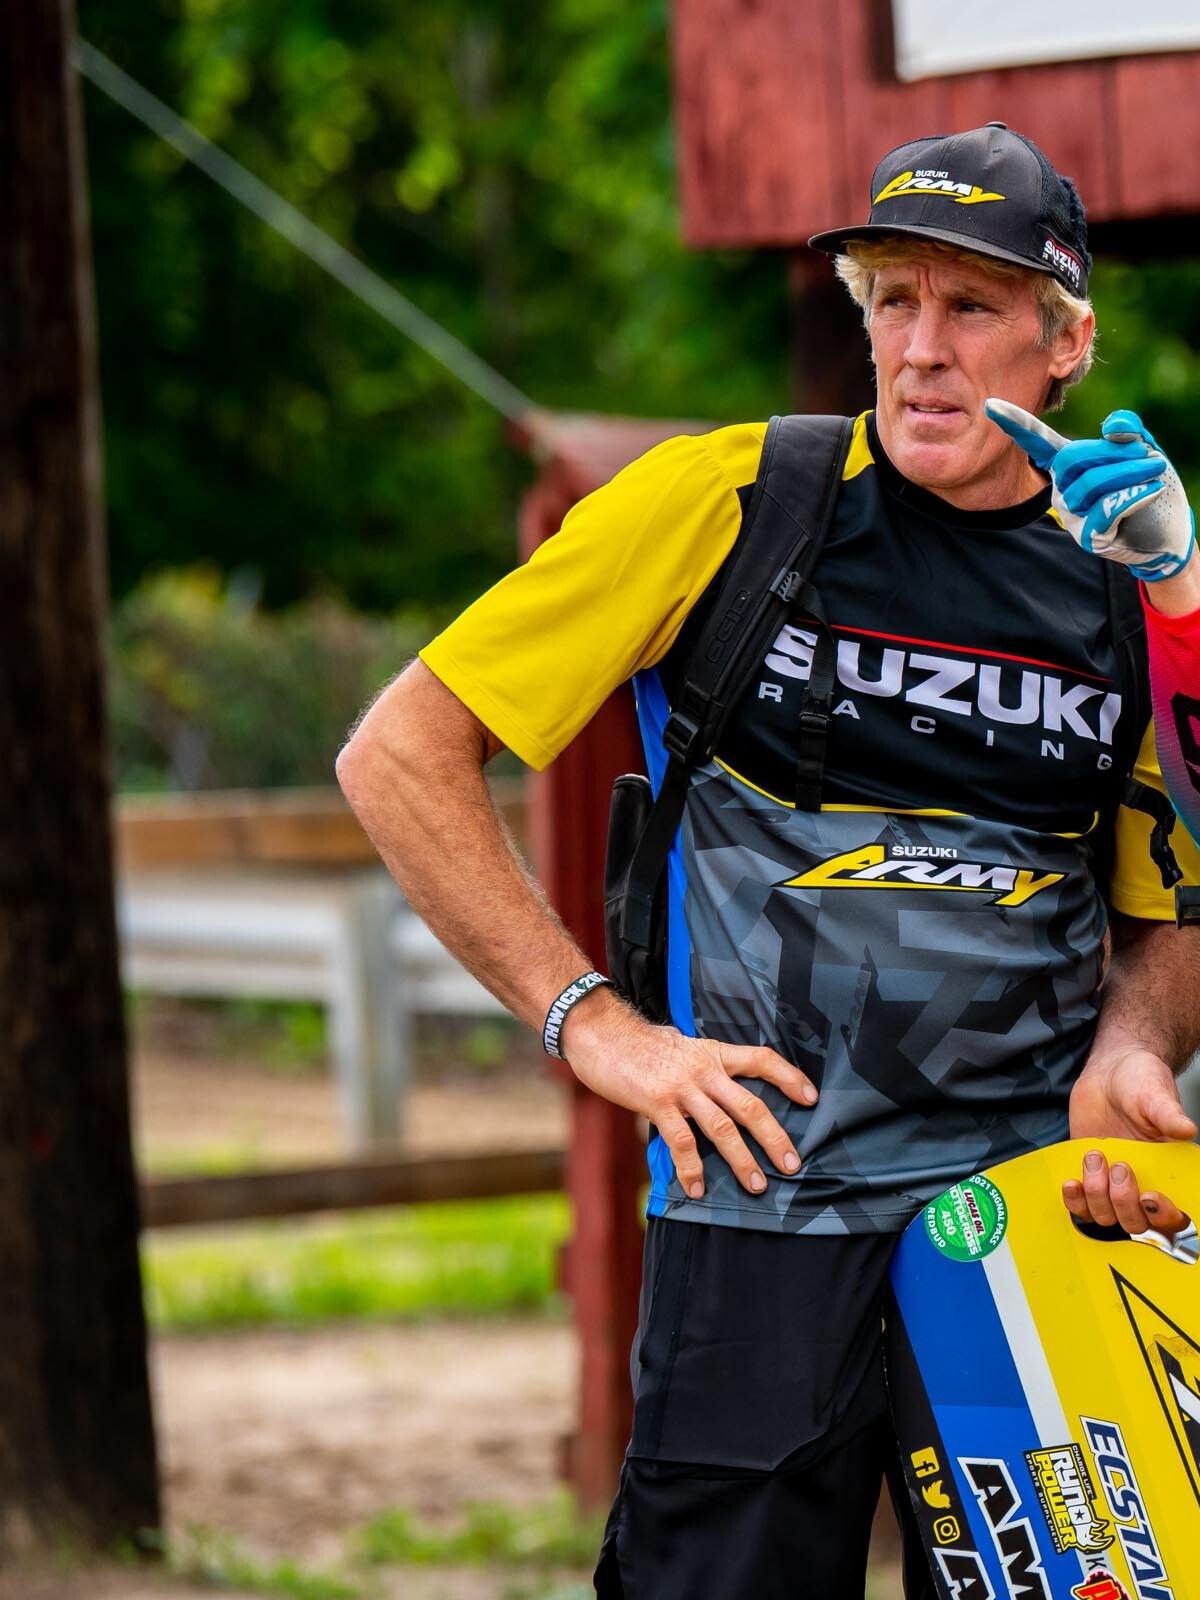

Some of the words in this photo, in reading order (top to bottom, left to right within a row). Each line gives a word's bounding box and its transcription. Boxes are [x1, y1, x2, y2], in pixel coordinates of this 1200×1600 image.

[915, 170, 949, 179] SUZUKI
[1044, 240, 1080, 281] SUZUKI
[764, 624, 1122, 745] SUZUKI
[758, 681, 1112, 771] RACING
[892, 846, 958, 859] SUZUKI
[784, 846, 1064, 906] ARMY
[969, 1175, 991, 1190] 2021
[941, 1210, 957, 1236] 450
[964, 1191, 980, 1219] LUCAS
[973, 1219, 985, 1234] OIL
[989, 1188, 1005, 1222] SIGNAL
[927, 1207, 946, 1248] REDBUD
[989, 1223, 1004, 1245] PASS
[1025, 1454, 1040, 1487] SPORTS
[1038, 1492, 1063, 1554] SUPPLEMENTS
[1035, 1454, 1077, 1545] POWER
[1049, 1450, 1092, 1525] RYNO
